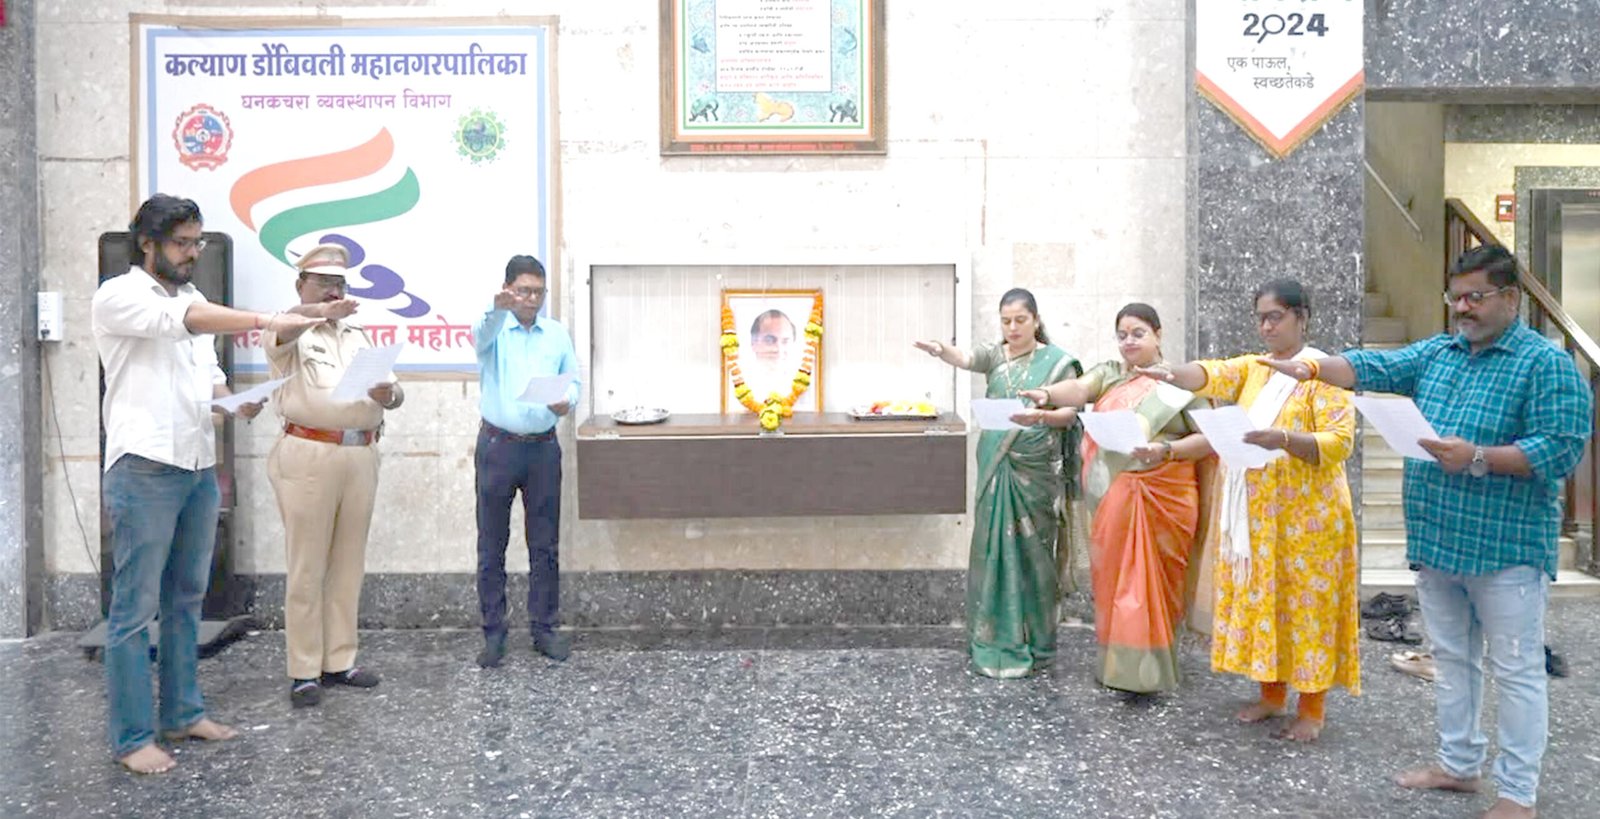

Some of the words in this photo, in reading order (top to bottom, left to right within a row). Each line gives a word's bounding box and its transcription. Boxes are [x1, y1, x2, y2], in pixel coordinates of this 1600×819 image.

[1243, 13, 1329, 44] 2024
[164, 54, 247, 76] कल्याण
[252, 43, 345, 76] डोंबिवली
[351, 43, 527, 80] महानगरपालिका
[1227, 57, 1248, 72] एक
[1252, 57, 1291, 71] पाऊल,
[1253, 72, 1315, 89] स्वच्छतेकडे
[241, 95, 309, 109] घनकचरा
[317, 95, 396, 110] व्यवस्थापन
[403, 88, 452, 109] विभाग
